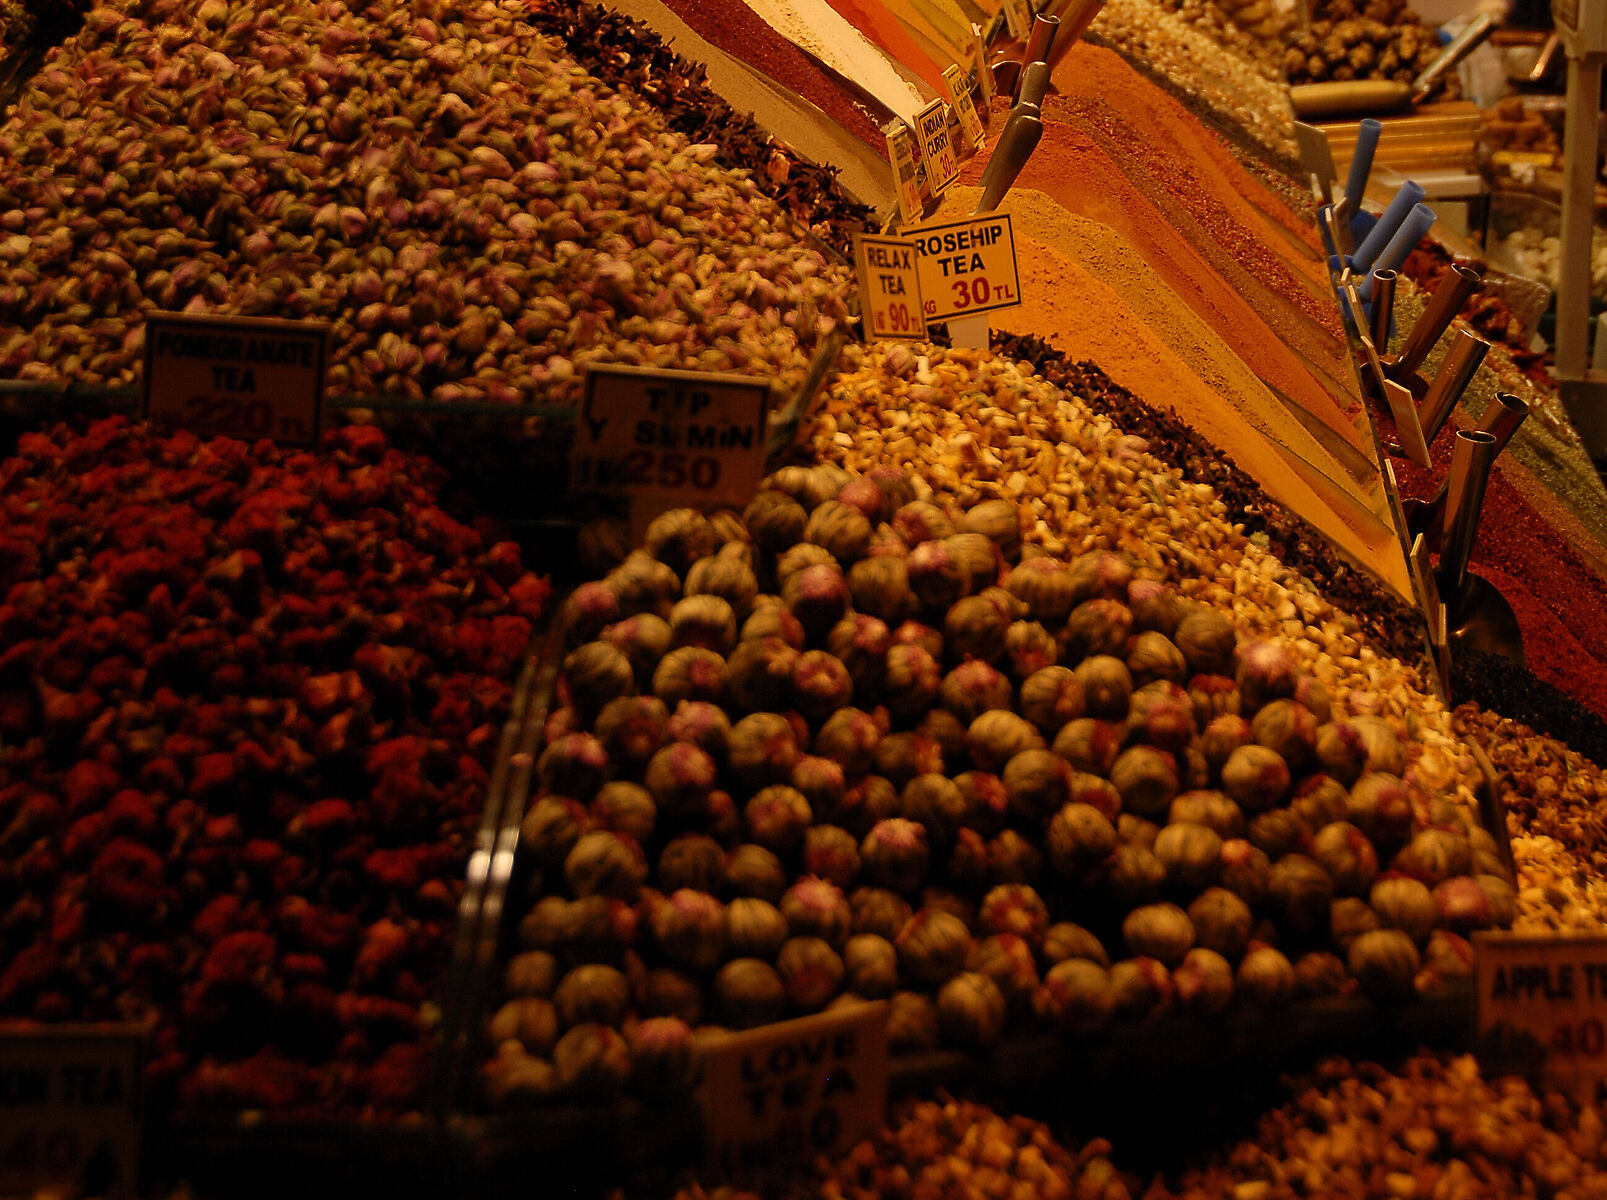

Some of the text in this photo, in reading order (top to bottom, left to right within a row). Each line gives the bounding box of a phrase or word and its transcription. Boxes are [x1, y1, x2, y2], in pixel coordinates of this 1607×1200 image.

[923, 111, 945, 139] INDIAN
[926, 129, 949, 158] CURRY
[939, 153, 951, 179] 30
[916, 225, 1003, 258] ROSEHIP
[868, 247, 912, 270] RELAX
[937, 252, 986, 277] TEA
[879, 274, 907, 296] TEA
[924, 276, 1014, 315] KG 30 TL
[889, 303, 910, 332] 90
[212, 365, 255, 392] TEA
[627, 448, 720, 489] 250
[1492, 962, 1573, 1000] APPLE
[742, 1033, 856, 1083] LOVE
[745, 1069, 854, 1115] TEA
